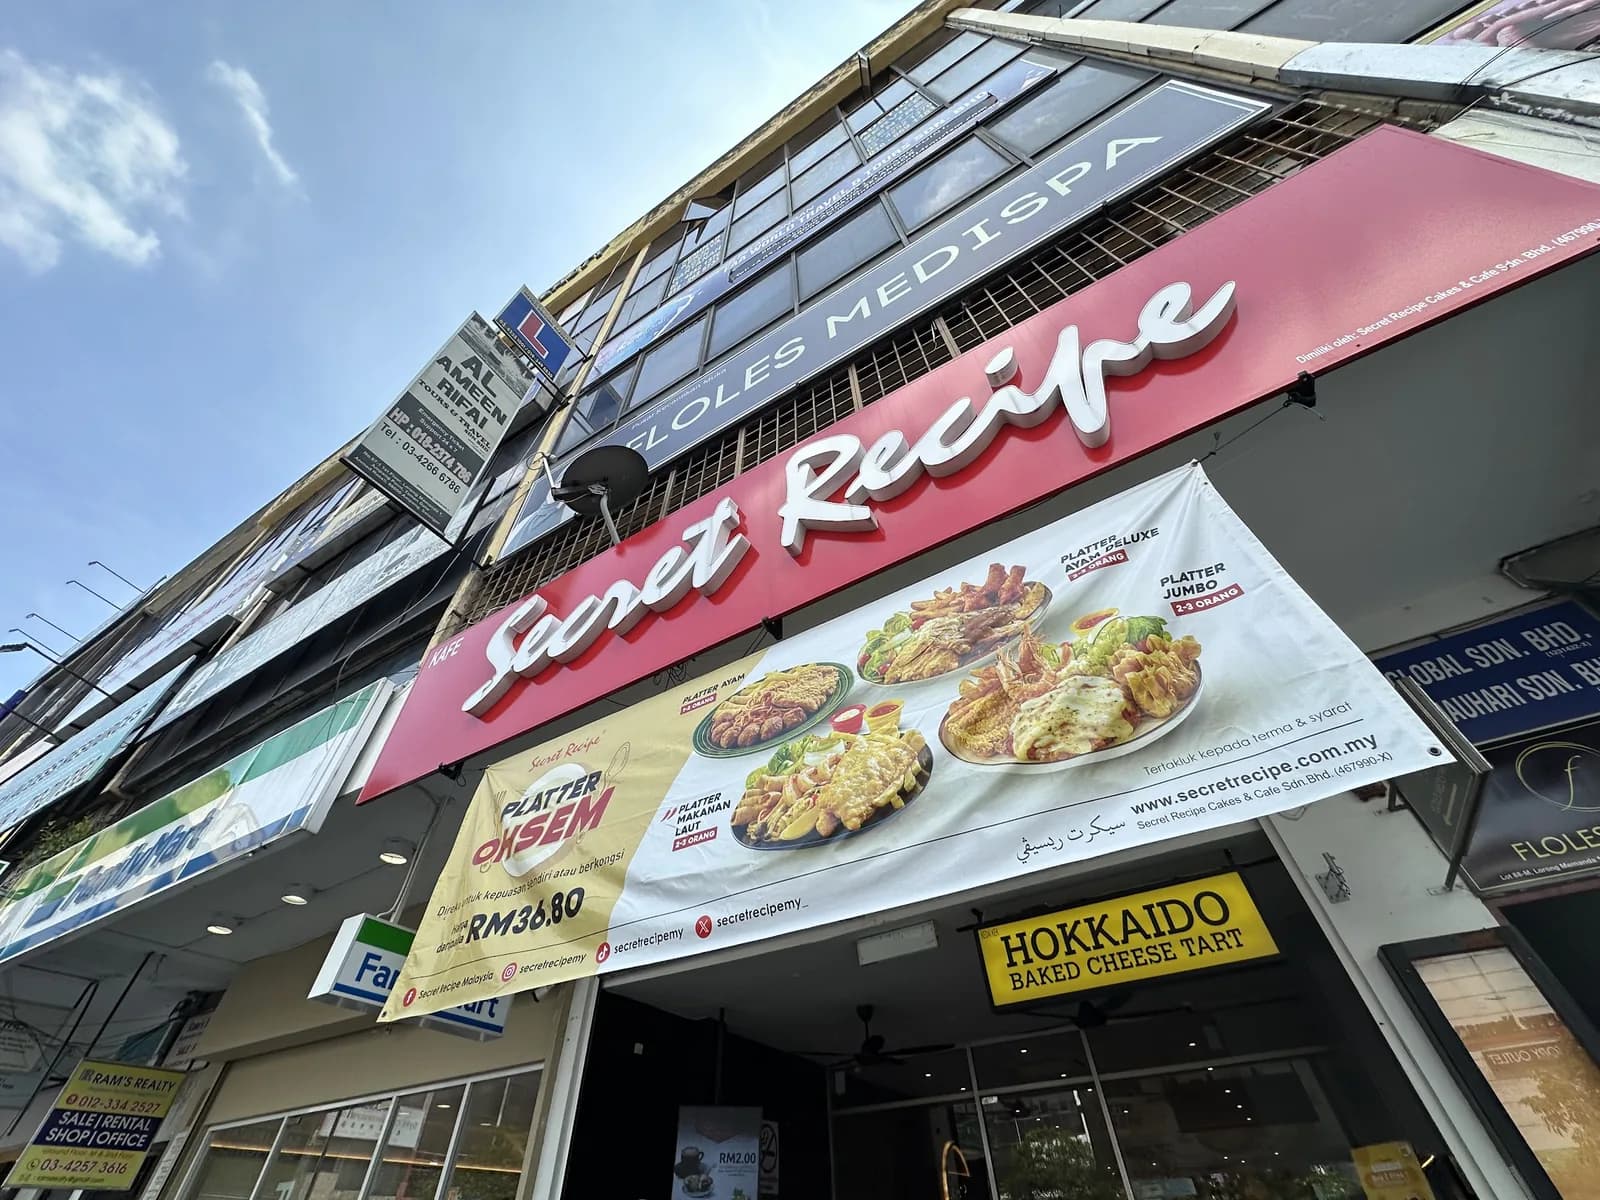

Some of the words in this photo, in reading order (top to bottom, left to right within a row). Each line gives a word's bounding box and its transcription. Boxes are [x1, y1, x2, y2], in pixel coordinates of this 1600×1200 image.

[625, 337, 807, 451] FLOLES
[826, 135, 1164, 340] MEDISPA
[1295, 343, 1334, 365] Dimiliki
[1355, 316, 1391, 337] Secret
[1389, 300, 1428, 321] Recipe
[1425, 284, 1462, 305] Cakes
[1458, 279, 1473, 290] &
[1471, 267, 1500, 285] Cafe
[1521, 244, 1556, 259] Bhd.
[436, 355, 508, 426] AMEEN
[460, 355, 497, 398] AL
[419, 379, 450, 410] TOURS
[459, 415, 490, 449] TRAVEL
[436, 377, 489, 429] RIFAI
[380, 422, 398, 439] Tel
[401, 441, 440, 475] 03-4266
[438, 472, 461, 494] 6786
[389, 407, 410, 425] HP
[453, 462, 472, 484] 786
[461, 497, 750, 718] Secret
[779, 280, 1237, 555] Recipe
[1060, 534, 1117, 564] PLATTER
[1065, 552, 1101, 573] AYAM
[1105, 527, 1160, 552] DELUXE
[1088, 552, 1126, 570] ORANG
[1160, 562, 1226, 588] PLATTER
[1163, 579, 1219, 600] JUMBO
[1175, 602, 1195, 613] 2-3
[1195, 587, 1240, 608] ORANG
[427, 636, 466, 668] KAFE
[1464, 638, 1531, 668] SDN.
[1520, 621, 1593, 652] BHD.
[682, 684, 719, 704] PLATTER
[720, 673, 745, 688] AYAM
[692, 696, 715, 708] ORANG
[1437, 682, 1528, 722] AUHARI
[1516, 669, 1584, 701] SDN.
[527, 748, 563, 773] Secret
[563, 736, 601, 758] Recipe
[1144, 753, 1198, 777] Tertakluk
[1199, 736, 1251, 761] kepada
[1252, 722, 1294, 745] terma
[1295, 716, 1307, 729] &
[1308, 701, 1353, 725] syarat
[501, 769, 603, 820] PLATTER
[1130, 732, 1379, 816] www.secretrecipe.com.my
[1136, 813, 1171, 831] Secret
[1171, 804, 1207, 826] Recipe
[1207, 794, 1243, 813] Cakes
[1244, 789, 1254, 801] &
[1253, 782, 1282, 800] Cafe
[1334, 751, 1394, 778] (467990-X)
[677, 799, 731, 825] MAKANAN
[678, 792, 722, 814] PLATTER
[471, 785, 616, 867] OHSEM
[674, 839, 687, 849] 2-3
[687, 830, 715, 844] ORANG
[675, 820, 702, 836] LAUT
[482, 884, 526, 902] kepuasan
[526, 870, 553, 891] sendiri
[553, 864, 577, 879] atau
[578, 848, 626, 875] berkongsi
[464, 887, 586, 945] RM36.80
[1000, 890, 1231, 968] HOKKAIDO
[519, 952, 587, 974] secretrecipemy
[613, 928, 685, 955] secretrecipemy
[1009, 961, 1081, 990] BAKED
[1087, 942, 1178, 976] CHEESE
[1181, 928, 1246, 957] TART
[418, 987, 439, 1000] Secret
[461, 970, 494, 988] Malaysia
[78, 1095, 129, 1111] 012-334
[130, 1102, 162, 1114] 2527
[92, 1073, 132, 1088] RAM'S
[134, 1078, 177, 1094] REALTY
[40, 1158, 97, 1173] 03-4257
[98, 1161, 128, 1175] 3616
[719, 1151, 756, 1165] RM2.00
